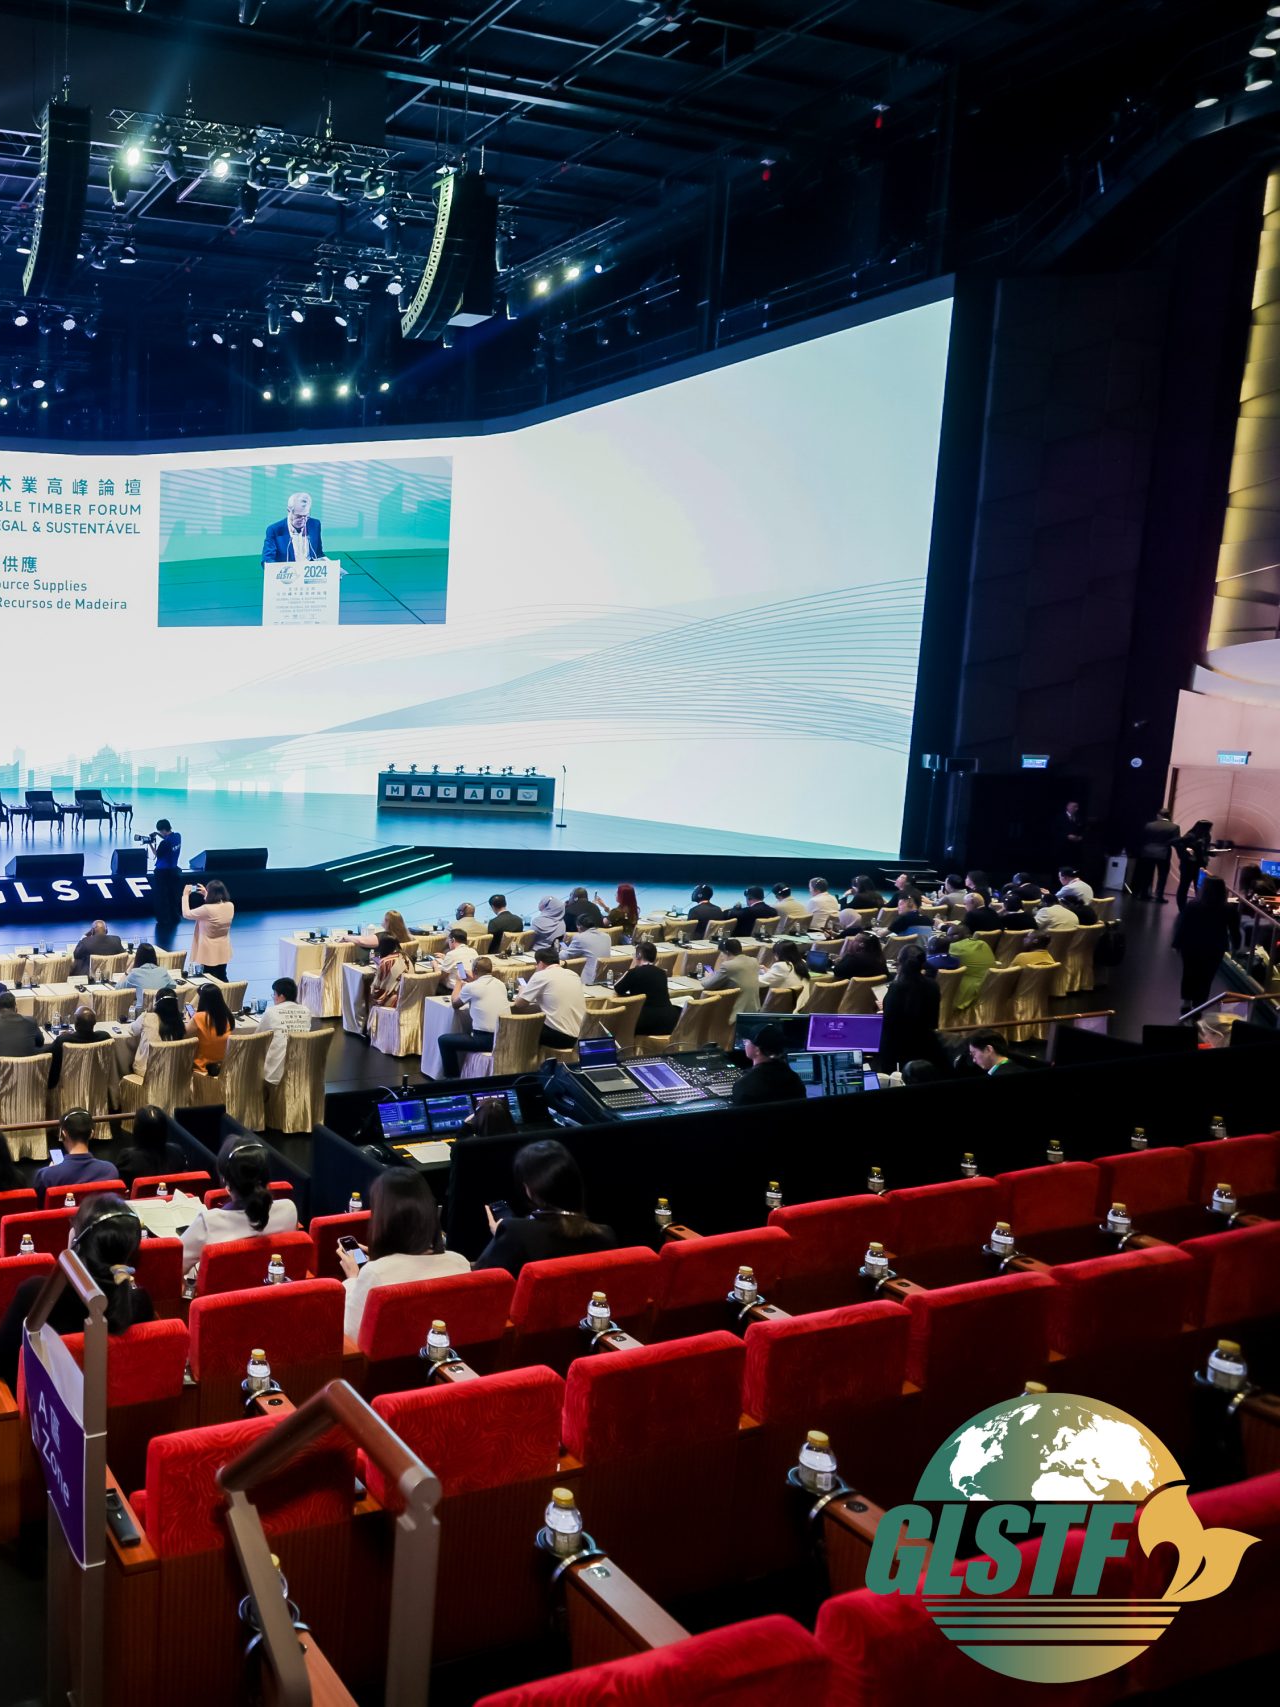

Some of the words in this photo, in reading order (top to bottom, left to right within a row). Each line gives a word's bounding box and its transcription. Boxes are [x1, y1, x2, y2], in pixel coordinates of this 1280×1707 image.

[27, 501, 82, 516] TIMBER
[88, 503, 142, 516] FORUM
[32, 520, 42, 533] &
[46, 520, 141, 535] SUSTENTÁVEL
[304, 565, 328, 578] 2024
[33, 579, 88, 594] Supplies
[56, 598, 71, 610] de
[74, 598, 127, 610] Madeira
[391, 786, 504, 799] MACAO
